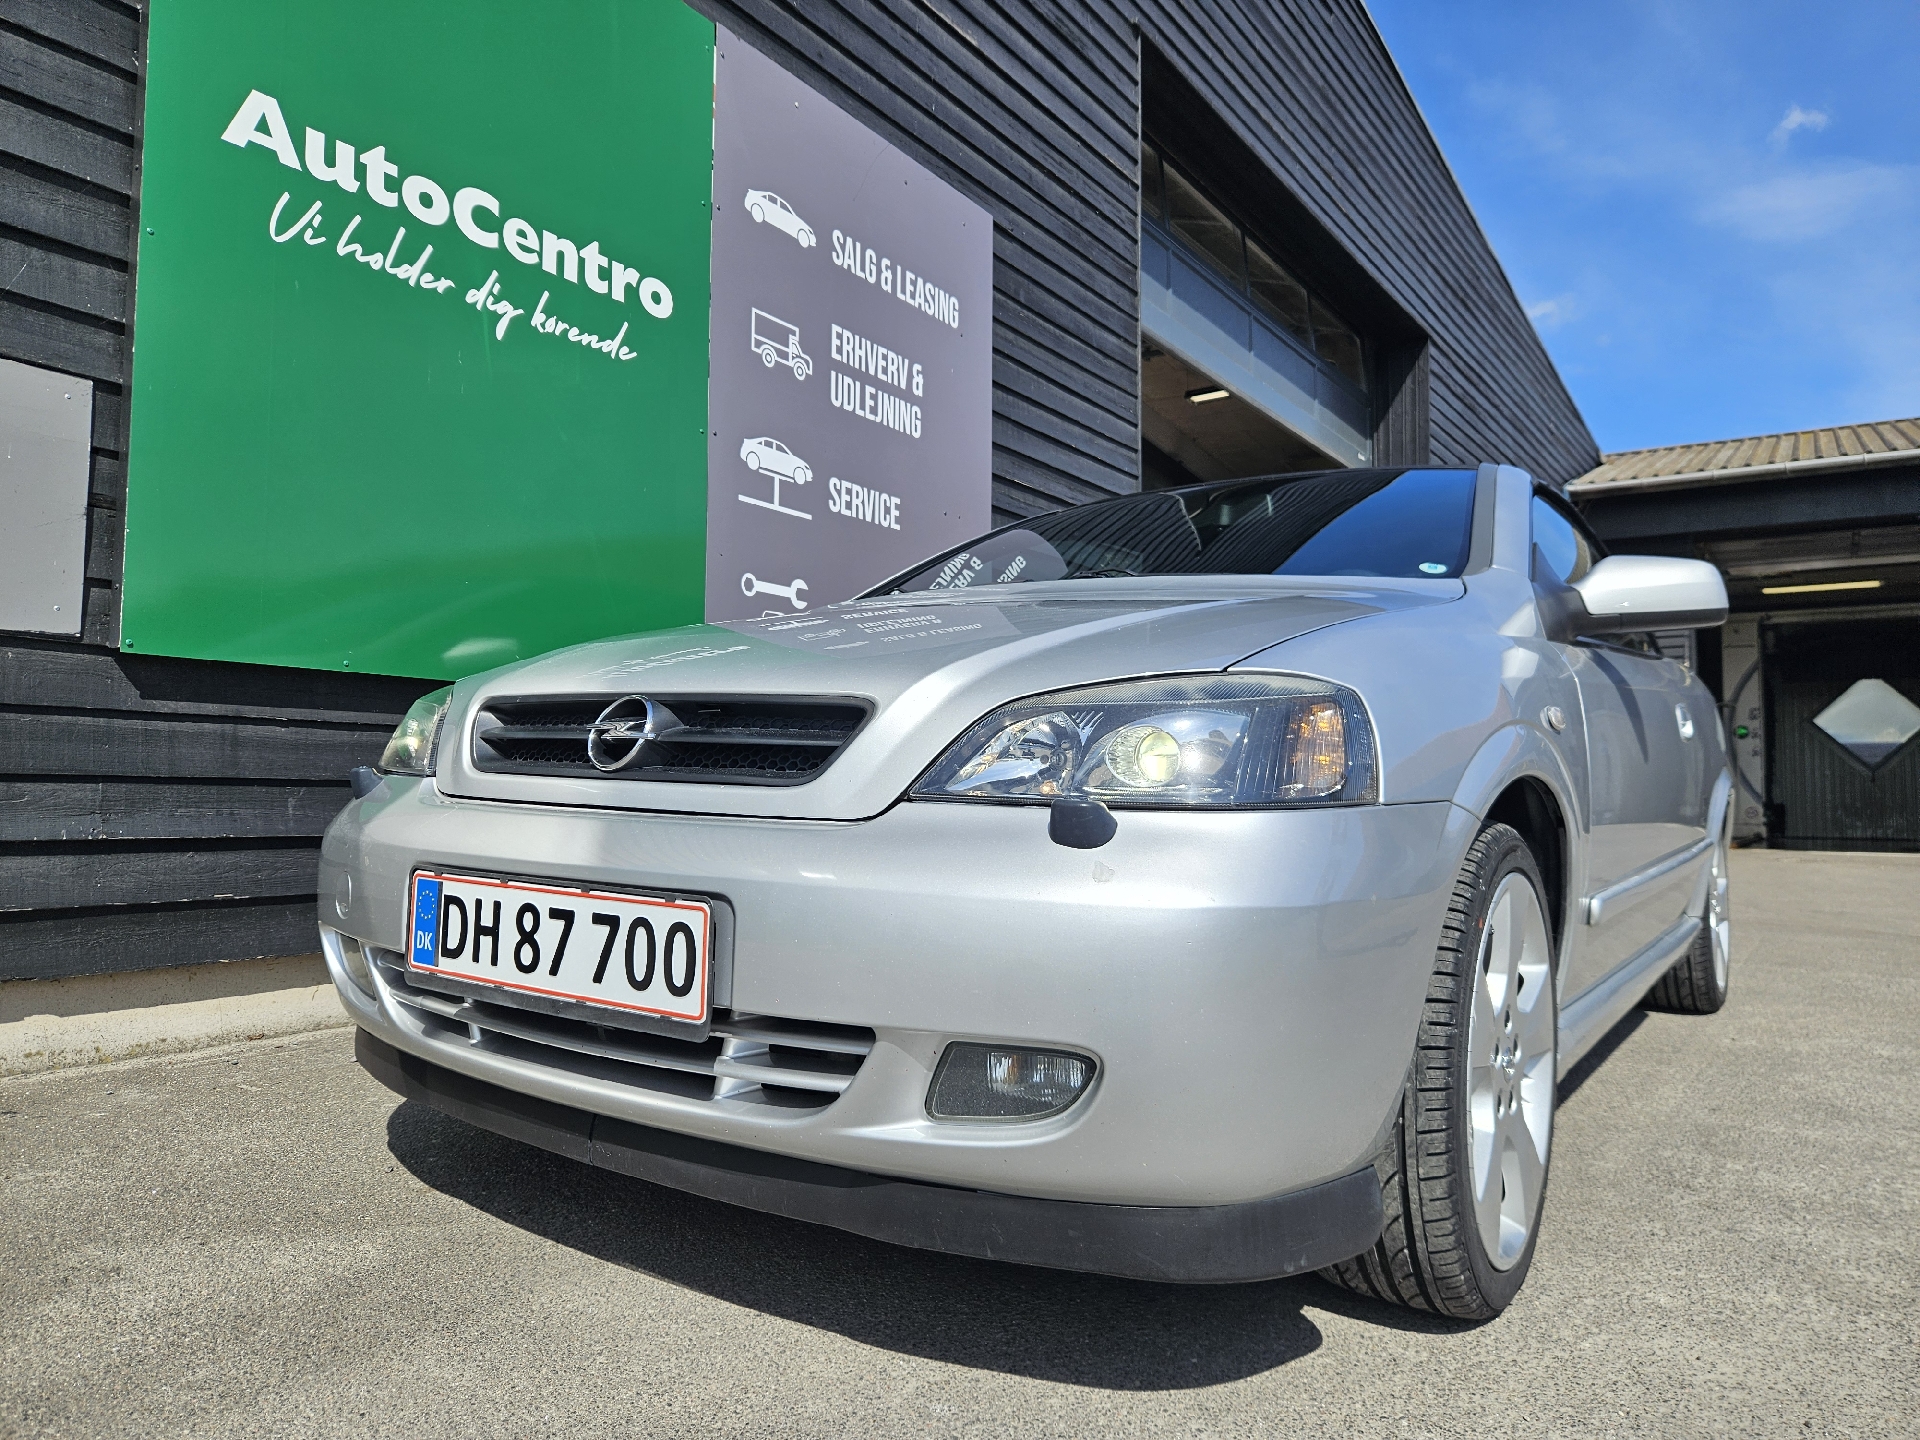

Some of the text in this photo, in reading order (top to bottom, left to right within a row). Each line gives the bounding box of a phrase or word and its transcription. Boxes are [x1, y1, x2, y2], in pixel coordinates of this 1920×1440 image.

[221, 89, 674, 319] AutoCentro
[269, 192, 327, 243] Vi
[336, 215, 456, 295] holder
[465, 270, 525, 341] dig
[832, 229, 959, 329] SALG & LEASING
[831, 323, 924, 397] ERHVERV &
[830, 370, 922, 439] UDLEJNING
[828, 477, 901, 531] SERVICE
[416, 930, 433, 951] DK
[440, 893, 697, 998] DH 87 700
